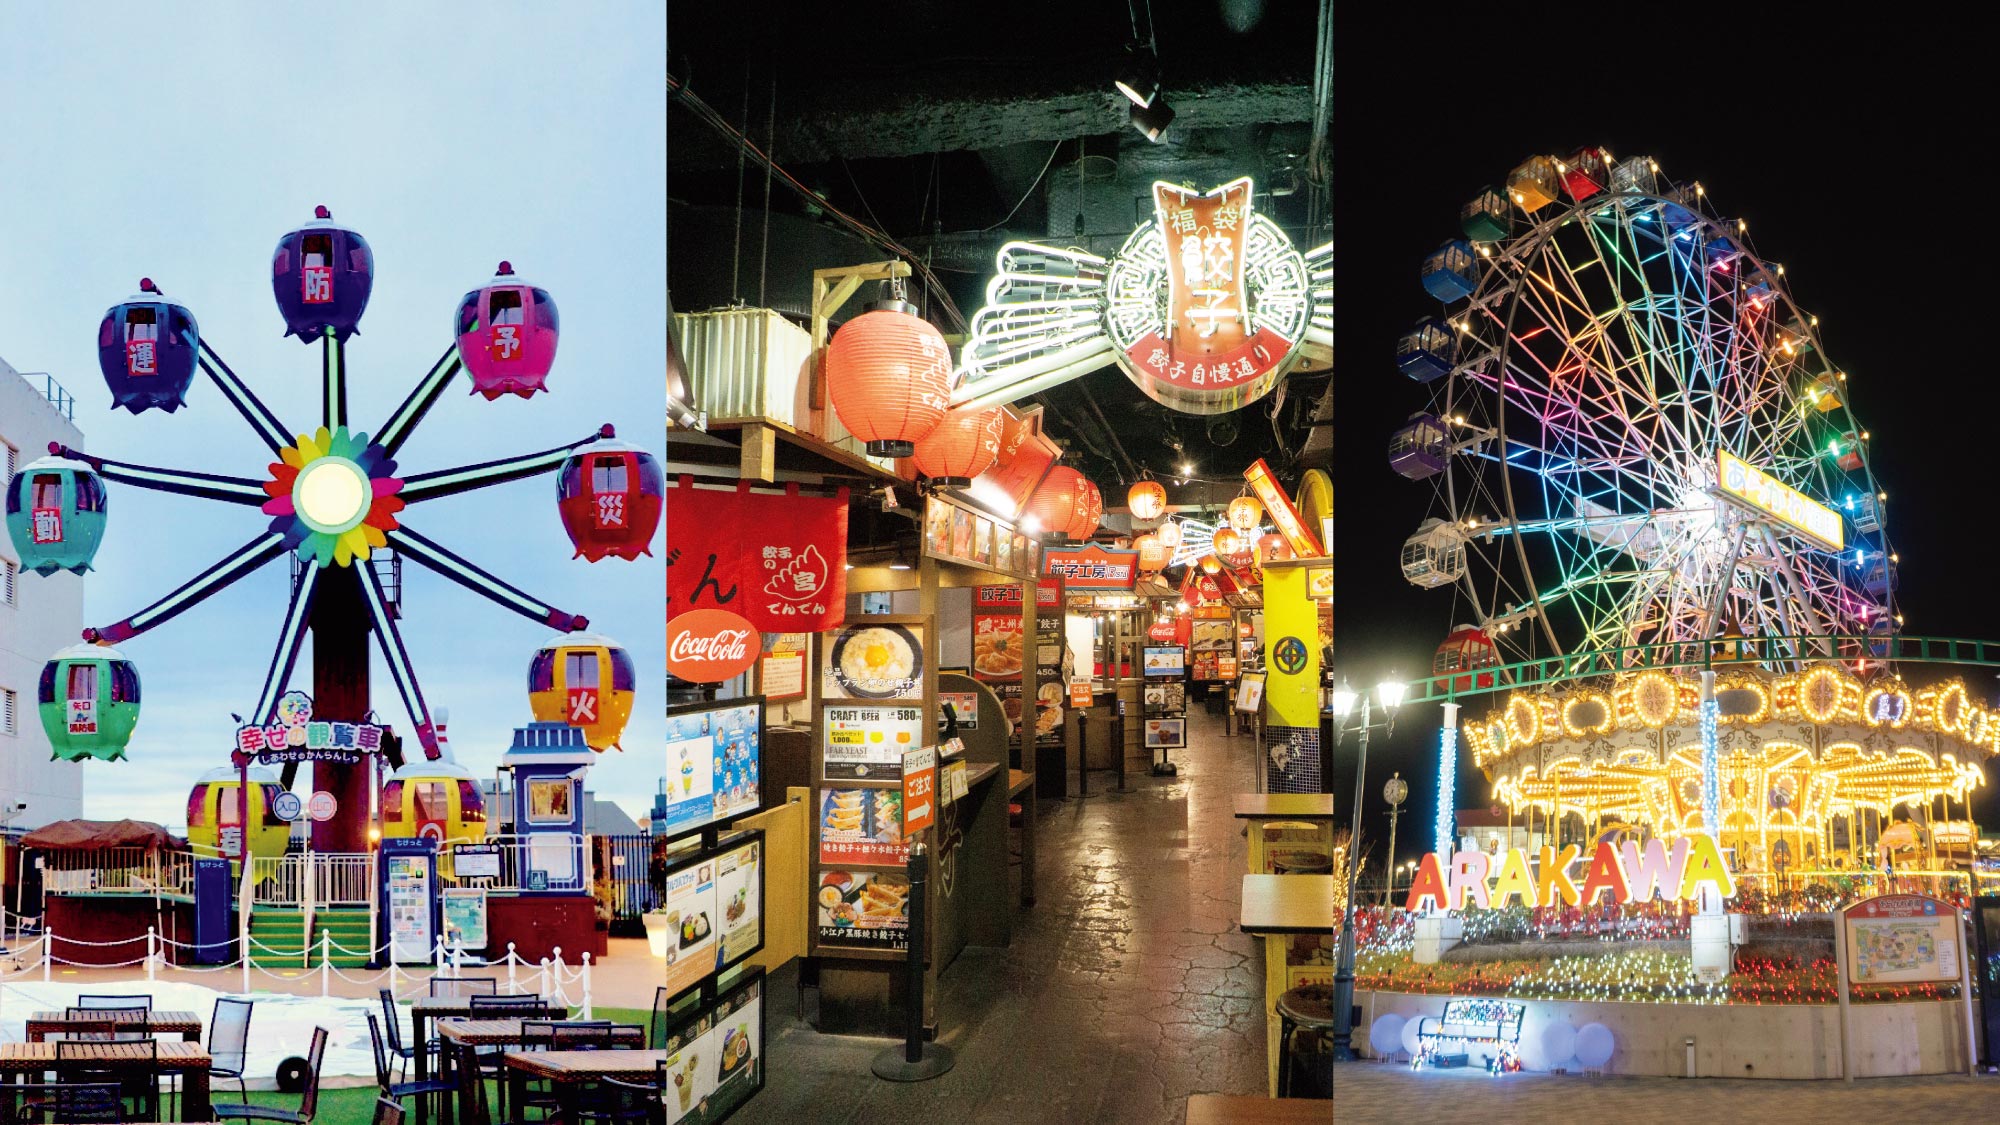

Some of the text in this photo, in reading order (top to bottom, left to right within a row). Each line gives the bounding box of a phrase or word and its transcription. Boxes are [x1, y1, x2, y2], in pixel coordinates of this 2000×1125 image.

[305, 269, 330, 301] 防
[1181, 232, 1239, 337] 餃子
[495, 327, 519, 358] 予
[129, 343, 155, 374] 運
[1147, 344, 1271, 385] 餃子自慢通り
[599, 494, 623, 526] 災
[35, 511, 60, 541] 動
[763, 546, 792, 559] 餃子
[764, 560, 776, 570] の
[793, 572, 816, 591] 宮
[981, 588, 1023, 601] 餃子工
[766, 603, 825, 615] でんでん
[670, 629, 750, 662] Coca-Cola
[570, 691, 596, 722] 火
[830, 710, 880, 721] CRAFT BEER
[241, 723, 380, 751] 幸せの観覧車
[908, 775, 931, 798] ご注文
[278, 799, 298, 812] 入口
[1405, 834, 1737, 912] ARAKAWA
[820, 928, 909, 940] 小江戸黒豚焼き餃子セ
